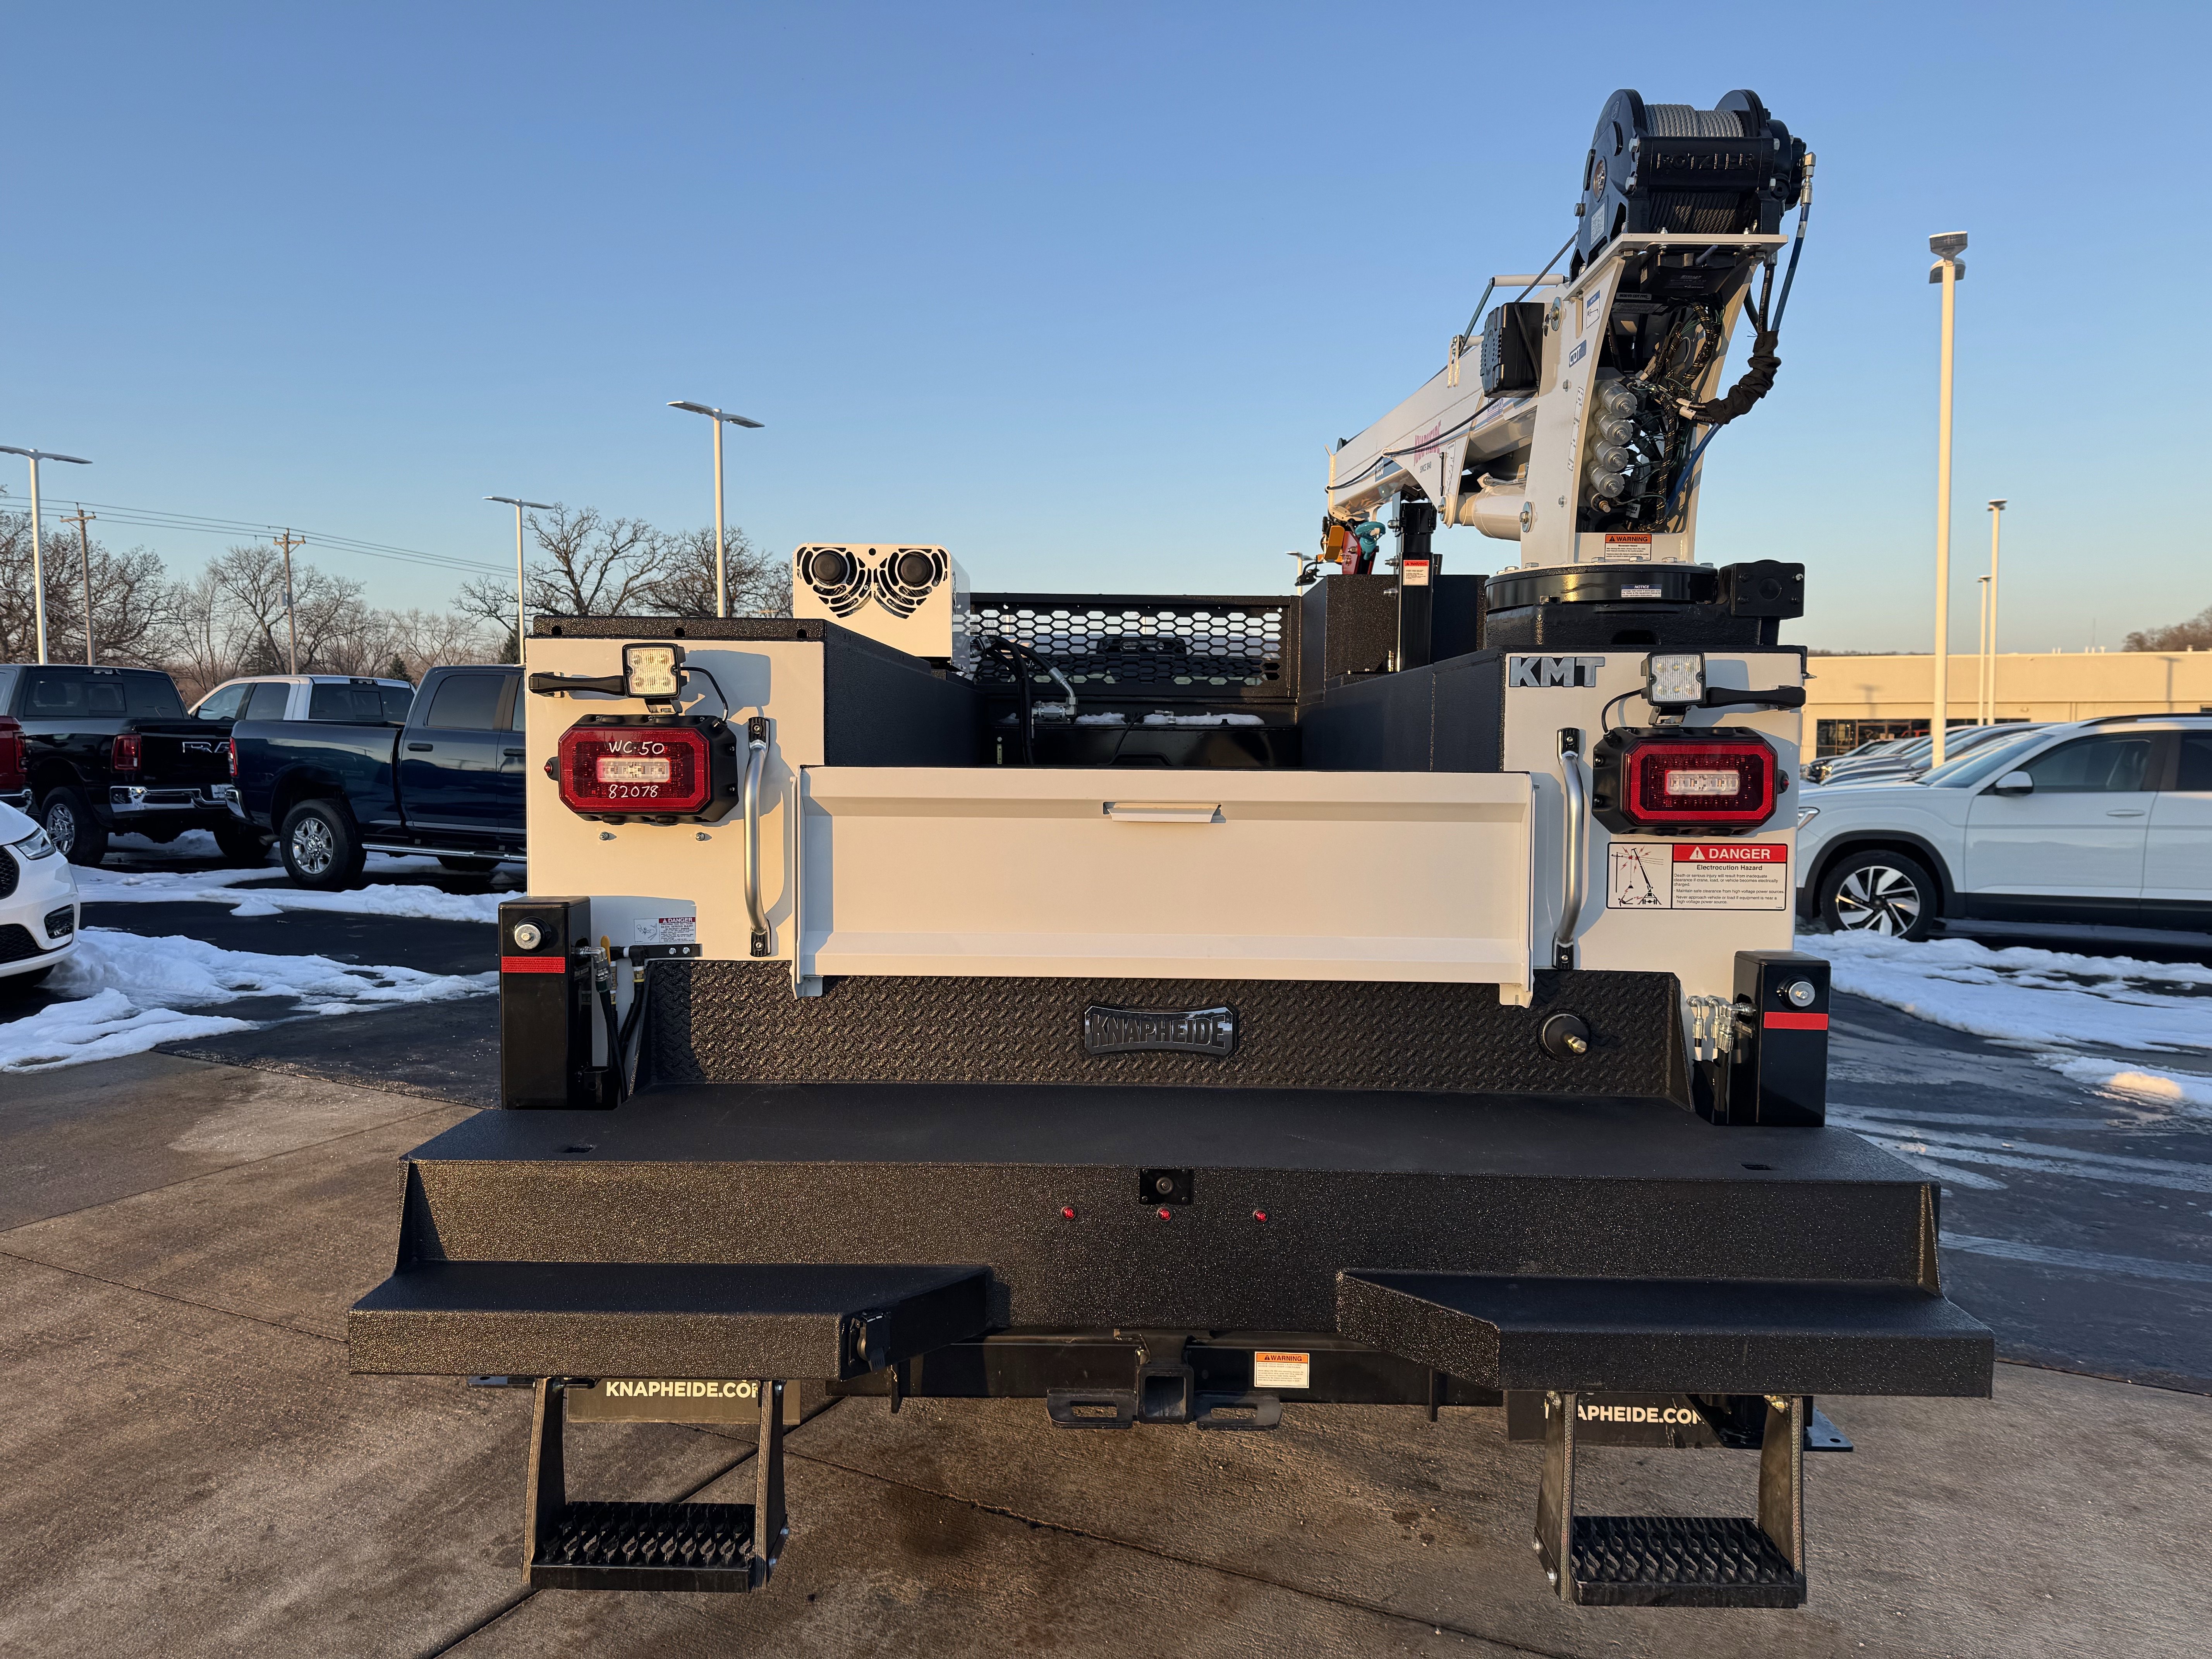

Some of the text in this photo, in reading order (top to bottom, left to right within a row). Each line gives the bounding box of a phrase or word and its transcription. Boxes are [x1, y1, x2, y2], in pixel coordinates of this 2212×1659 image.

[1657, 153, 1754, 170] ROTZLER
[1569, 345, 1581, 366] CDT
[1509, 656, 1605, 687] KMT
[182, 742, 230, 753] RA
[609, 784, 659, 799] 82078
[1709, 848, 1771, 860] DANGER
[1092, 1014, 1226, 1048] KNAPHEIDE
